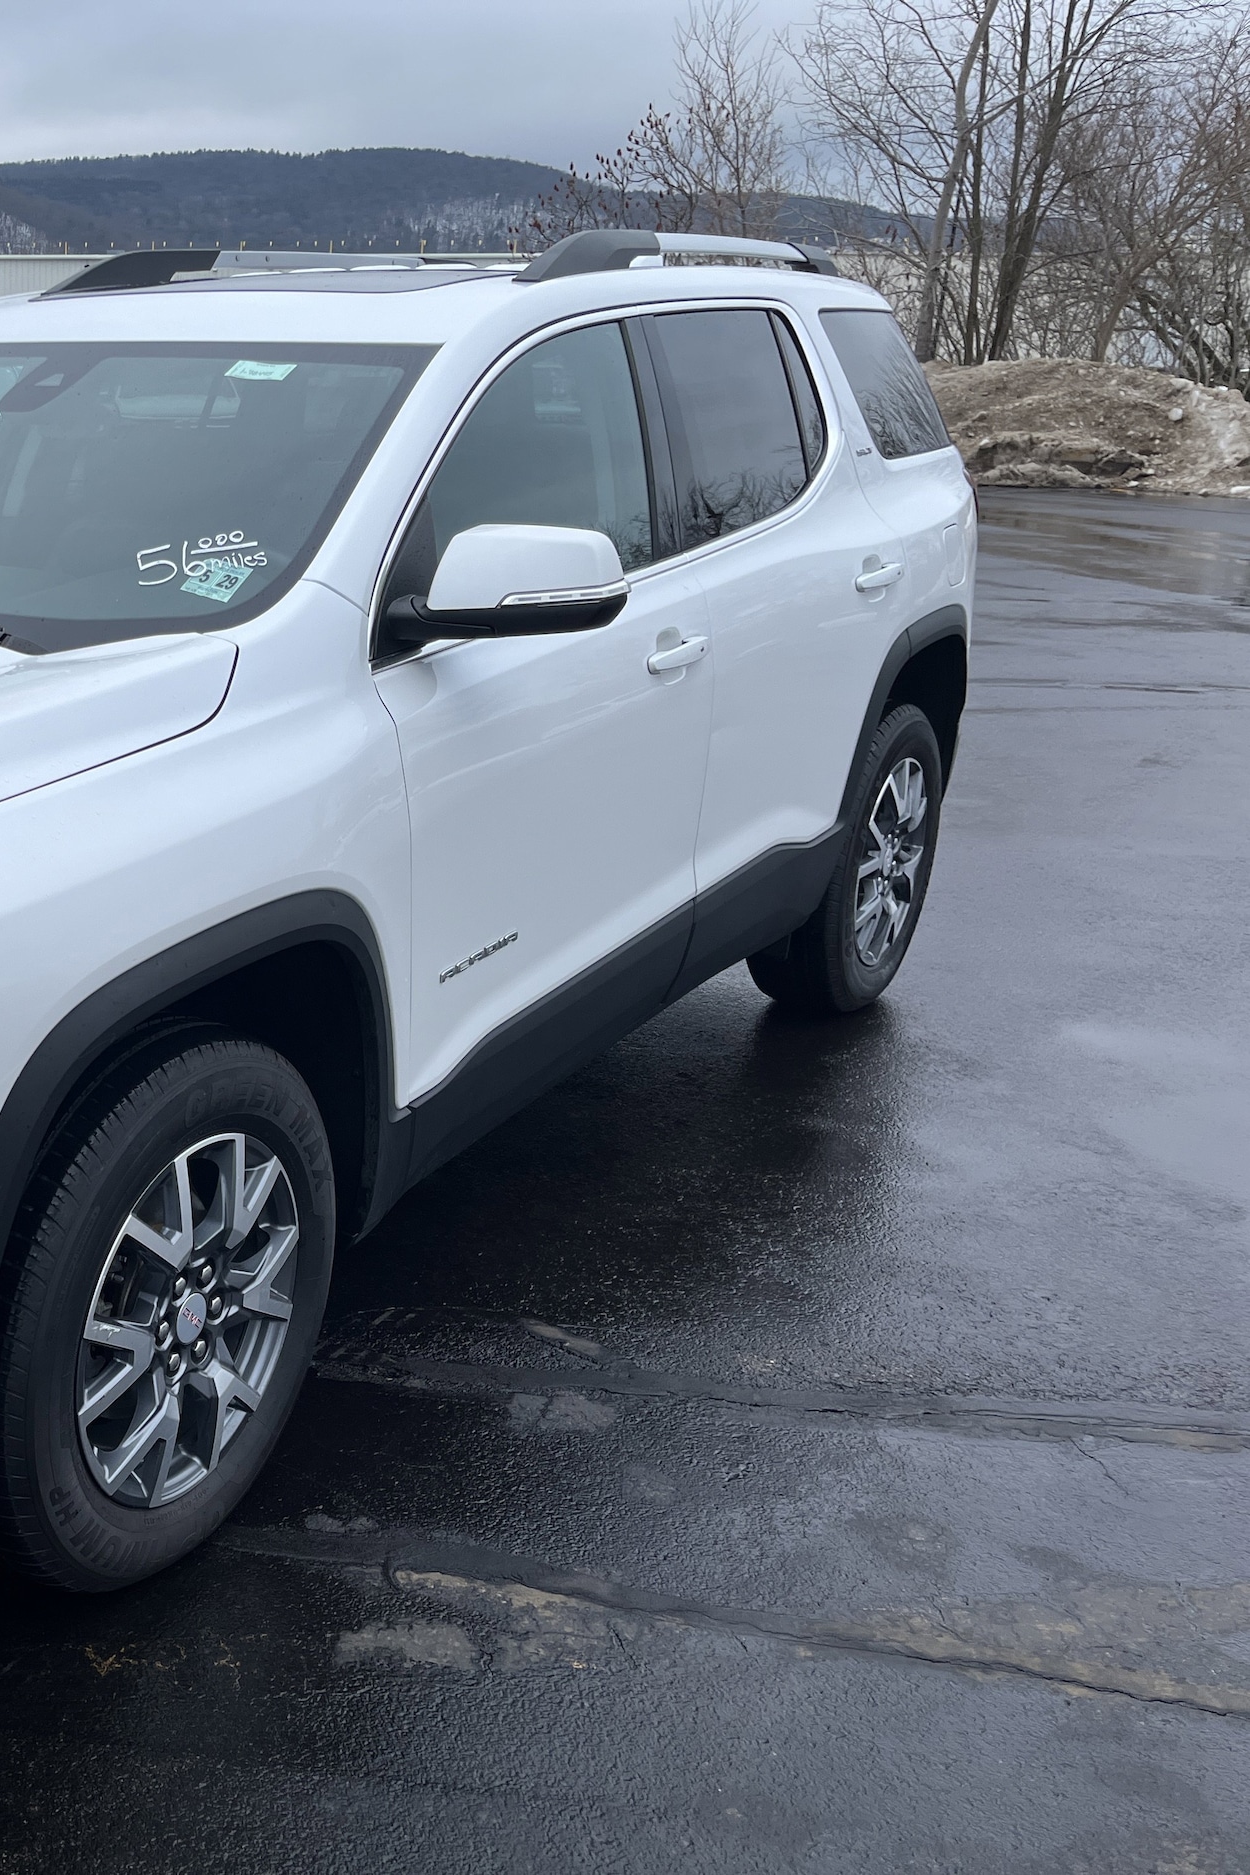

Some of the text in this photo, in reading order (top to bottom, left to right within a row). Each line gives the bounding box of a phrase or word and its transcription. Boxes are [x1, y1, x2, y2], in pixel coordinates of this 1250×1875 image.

[198, 530, 244, 549] 000
[136, 541, 207, 586] 56
[210, 551, 268, 572] miles
[198, 569, 239, 590] 5 29
[439, 930, 519, 984] ACADIA
[289, 1103, 333, 1193] MAX
[182, 1307, 203, 1329] GMC
